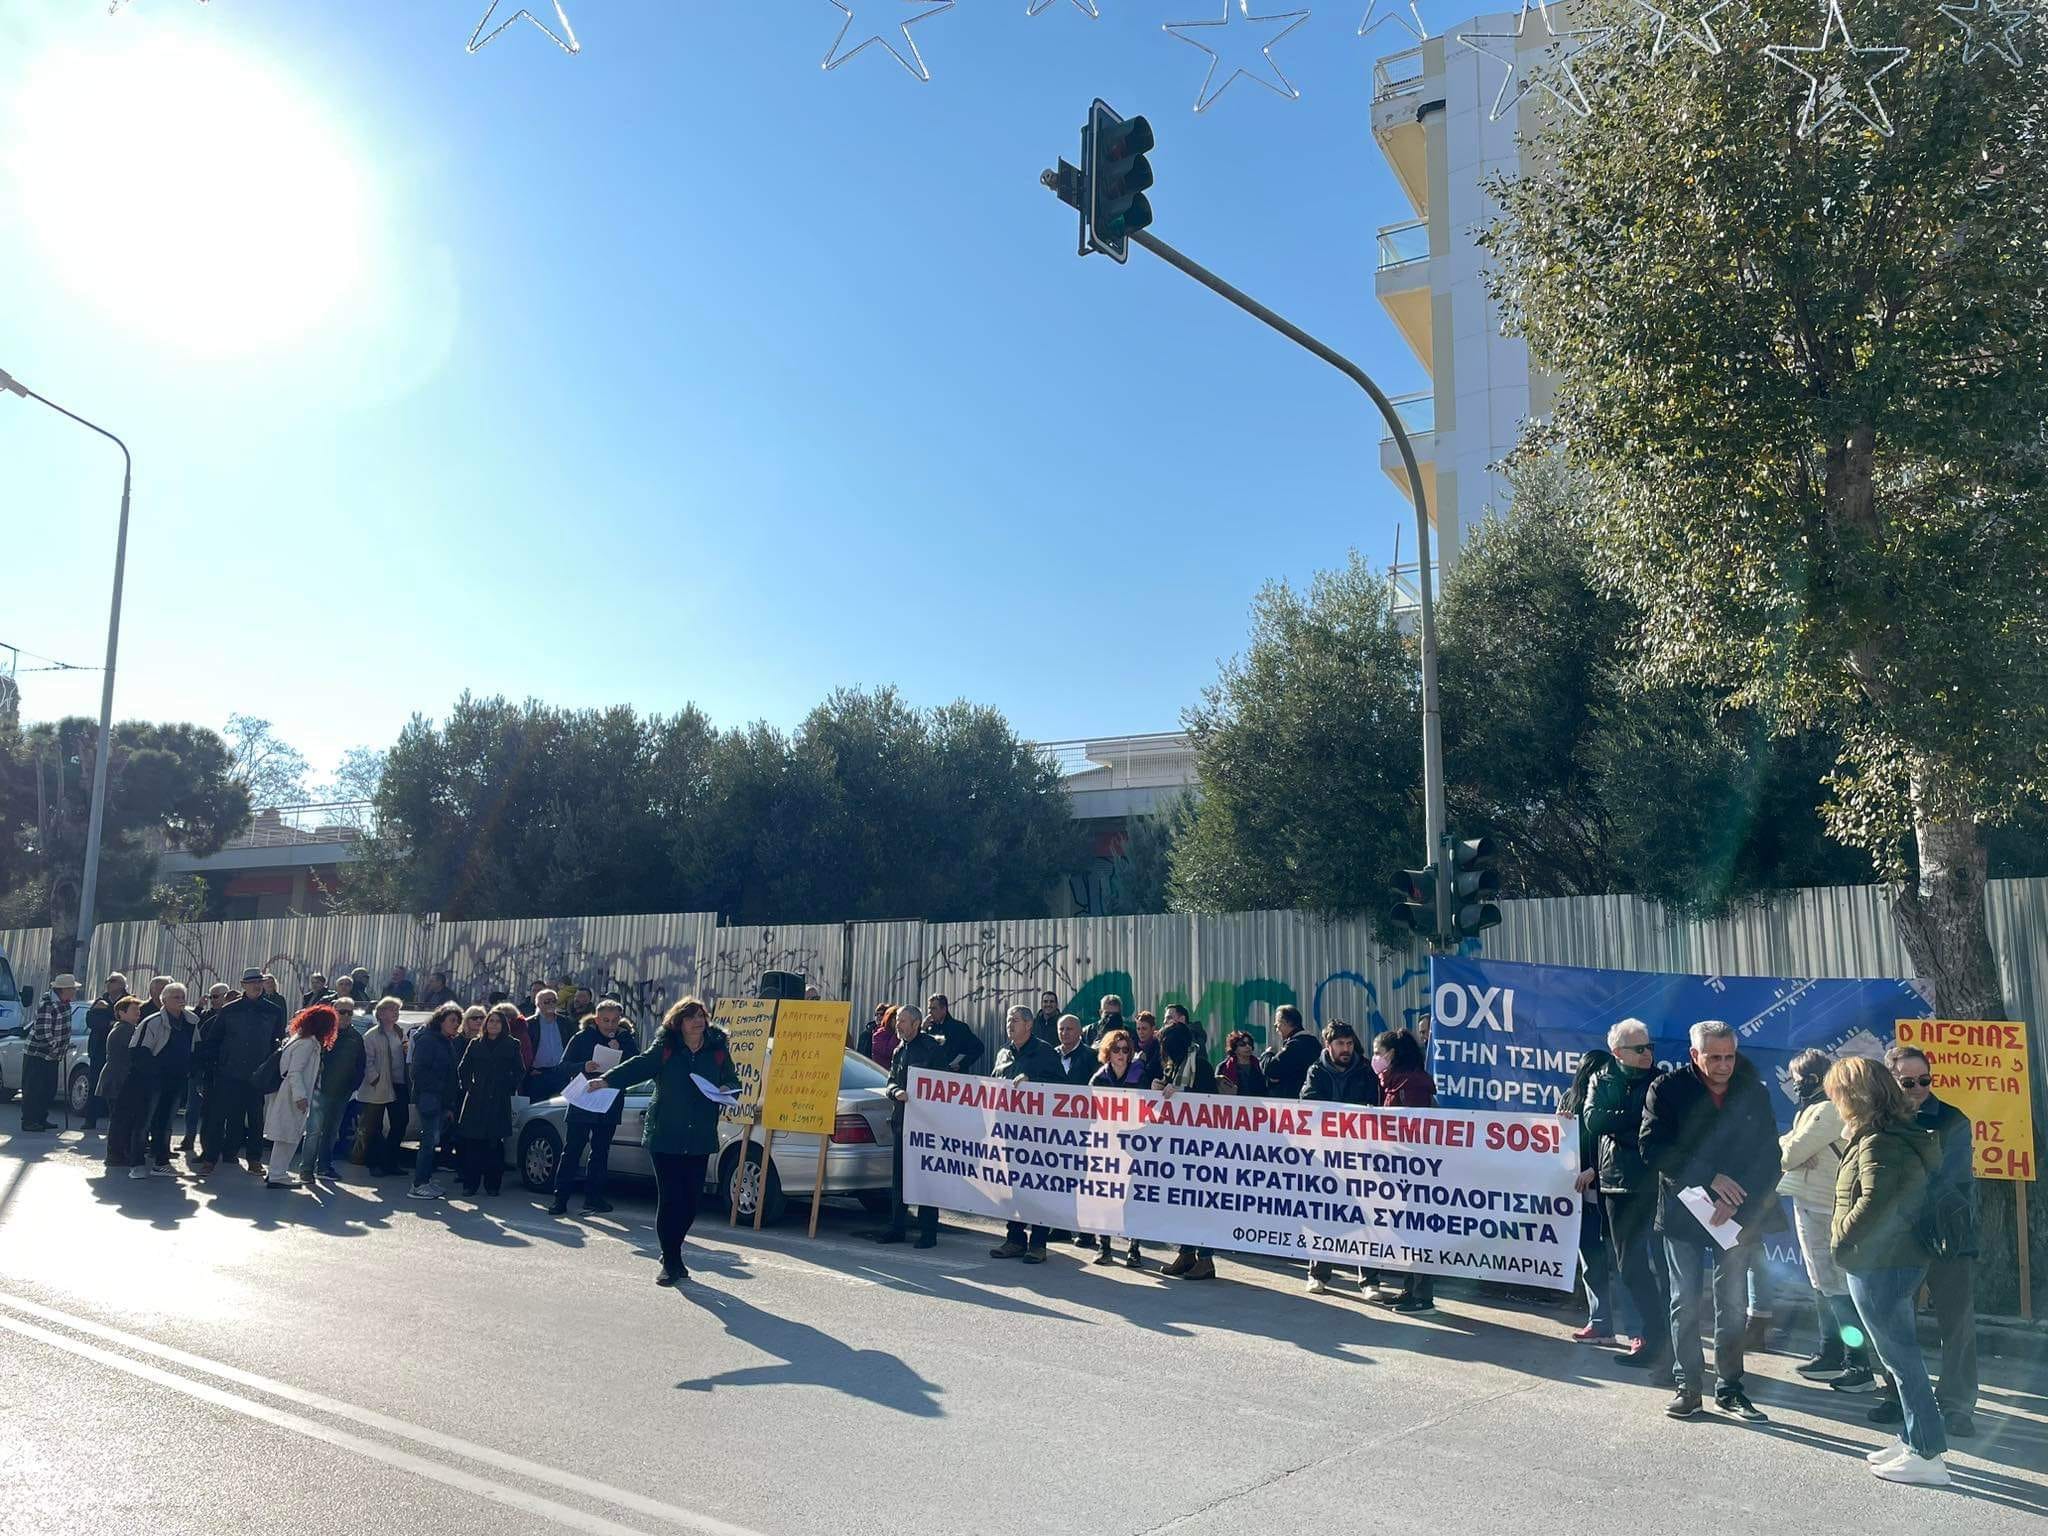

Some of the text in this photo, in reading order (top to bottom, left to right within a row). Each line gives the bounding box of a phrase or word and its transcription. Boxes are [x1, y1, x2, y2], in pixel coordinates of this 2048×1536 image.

[1435, 982, 1514, 1032] ΟΧΙ
[732, 1042, 754, 1052] ΓΑΘΟ
[1433, 1039, 1585, 1074] ΣΤΗΝ ΤΣΙΜΕ
[1899, 1023, 2024, 1050] Ο ΑΓΩΝΑΣ
[1932, 1074, 2020, 1095] ΕΑΝ ΥΓΕΙΑ
[917, 1077, 1559, 1153] ΠΑΡΑΛΙΑΚΗ ΖΩΝΗ ΚΑΛΑΜΑΡΙΑΣ ΕΚΠΕΜΠΕΙ SOS!
[910, 1132, 1574, 1216] ΜΕ ΧΡΗΜΑΤΟΔΟΤΗΣΗ ΑΠΟ ΤΟΝ ΚΡΑΤΙΚΟ ΠΡΟΫΠΟΛΟΓΙΣΜΟ
[991, 1123, 1443, 1177] ΑΝΑΠΛΑΣΗ ΤΟΥ ΠΑΡΑΛΙΑΚΟΥ ΜΕΤΩΠΟΥ
[921, 1155, 1558, 1244] ΚΑΜΙΑ ΠΑΡΑΧΩΡΗΣΗ ΣΕ ΕΠΙΧΕΙΡΗΜΑΤΙΚΑ ΣΥΜΦΕΡΟΝΤΑ
[1233, 1227, 1563, 1278] ΦΟΡΕΙΣ & ΣΩΜΑΤΕΙΑ ΤΗΣ ΚΑΛΑΜΑΡΙΑΣ
